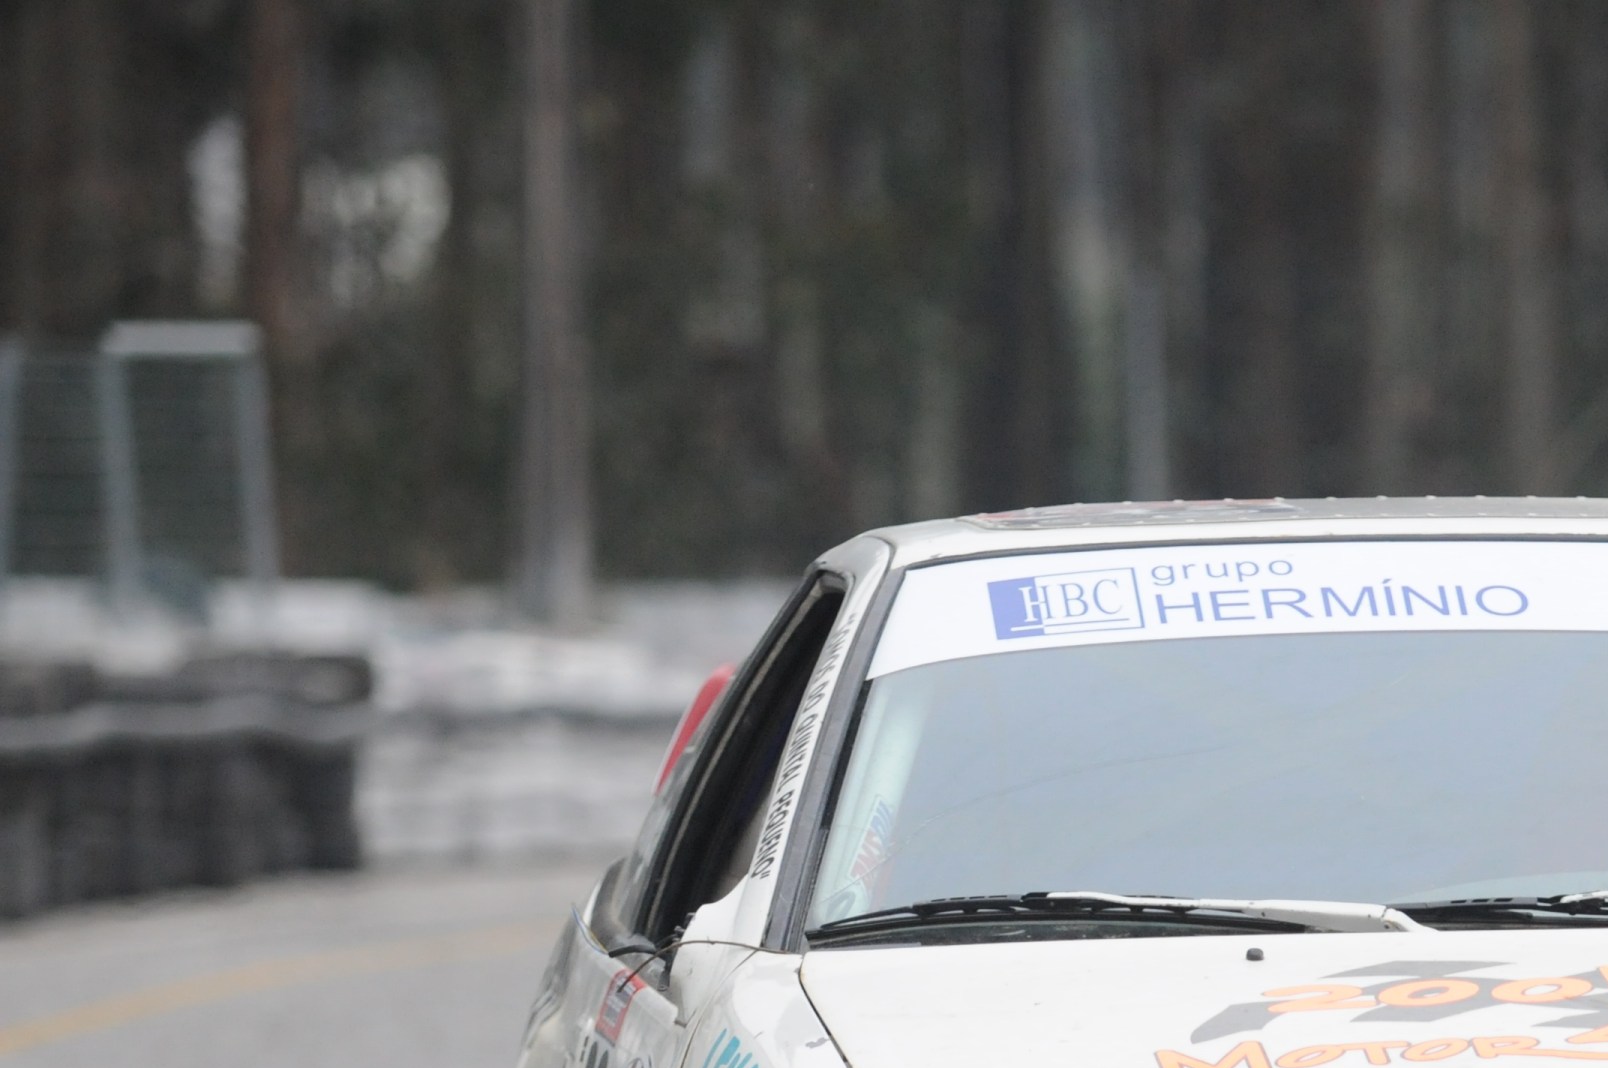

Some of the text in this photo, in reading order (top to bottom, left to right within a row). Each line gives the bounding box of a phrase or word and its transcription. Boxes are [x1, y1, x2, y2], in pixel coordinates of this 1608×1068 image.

[1152, 556, 1294, 586] grupo
[1018, 578, 1124, 623] HBC
[1155, 578, 1530, 625] HERMÍNIO
[778, 713, 818, 792] QUINTAL
